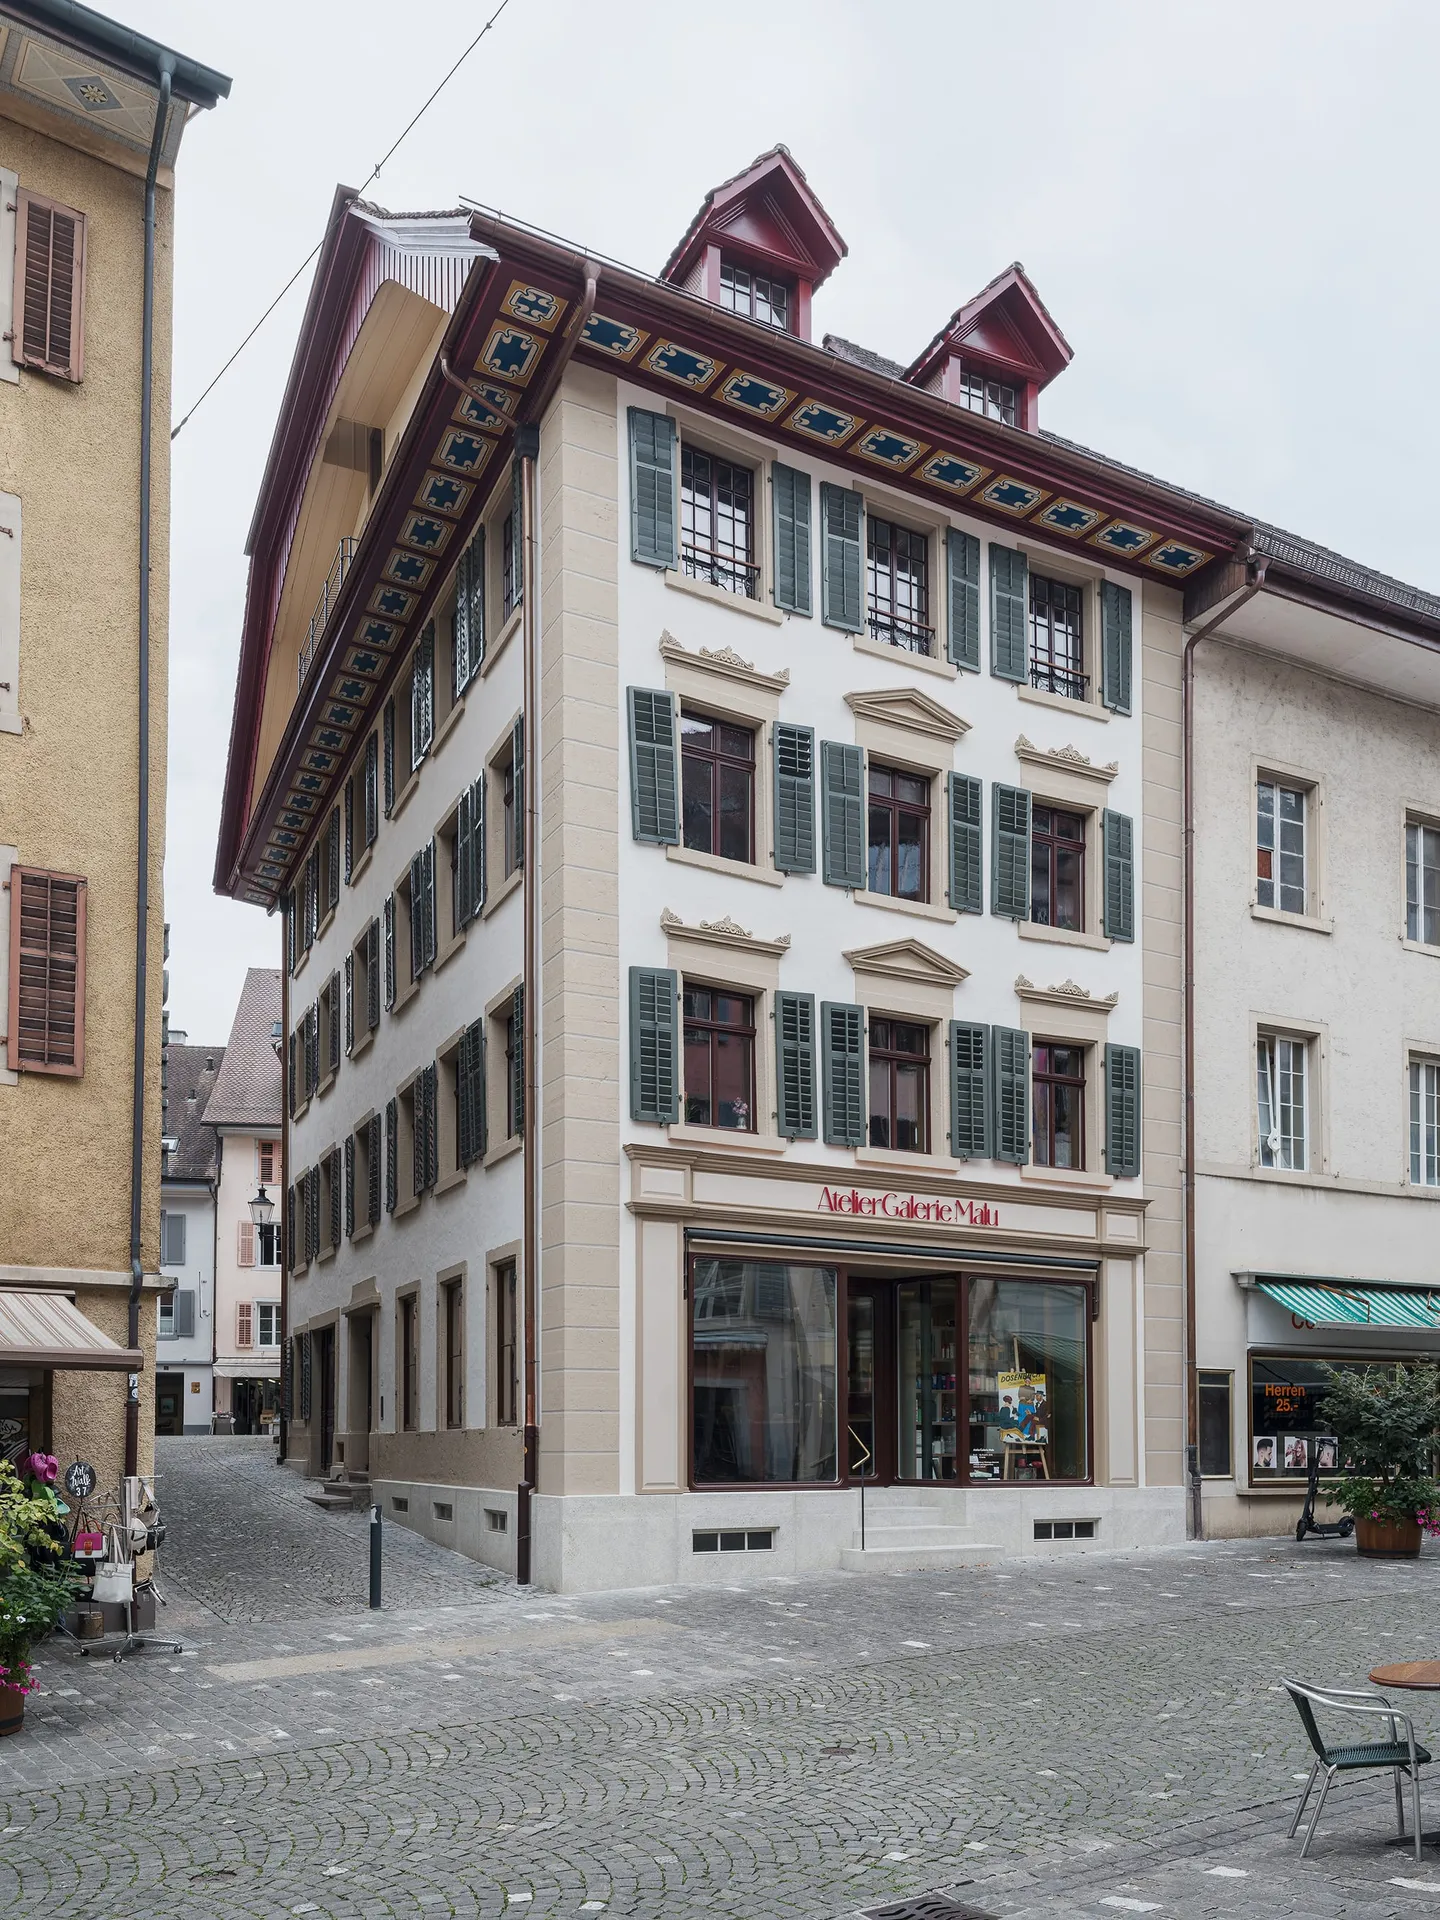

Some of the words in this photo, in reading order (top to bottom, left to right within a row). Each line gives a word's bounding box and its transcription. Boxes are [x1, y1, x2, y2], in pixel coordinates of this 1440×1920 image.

[955, 1200, 999, 1227] Malu
[1265, 1384, 1305, 1396] Herren
[73, 1465, 85, 1476] Art
[76, 1487, 87, 1496] 37
